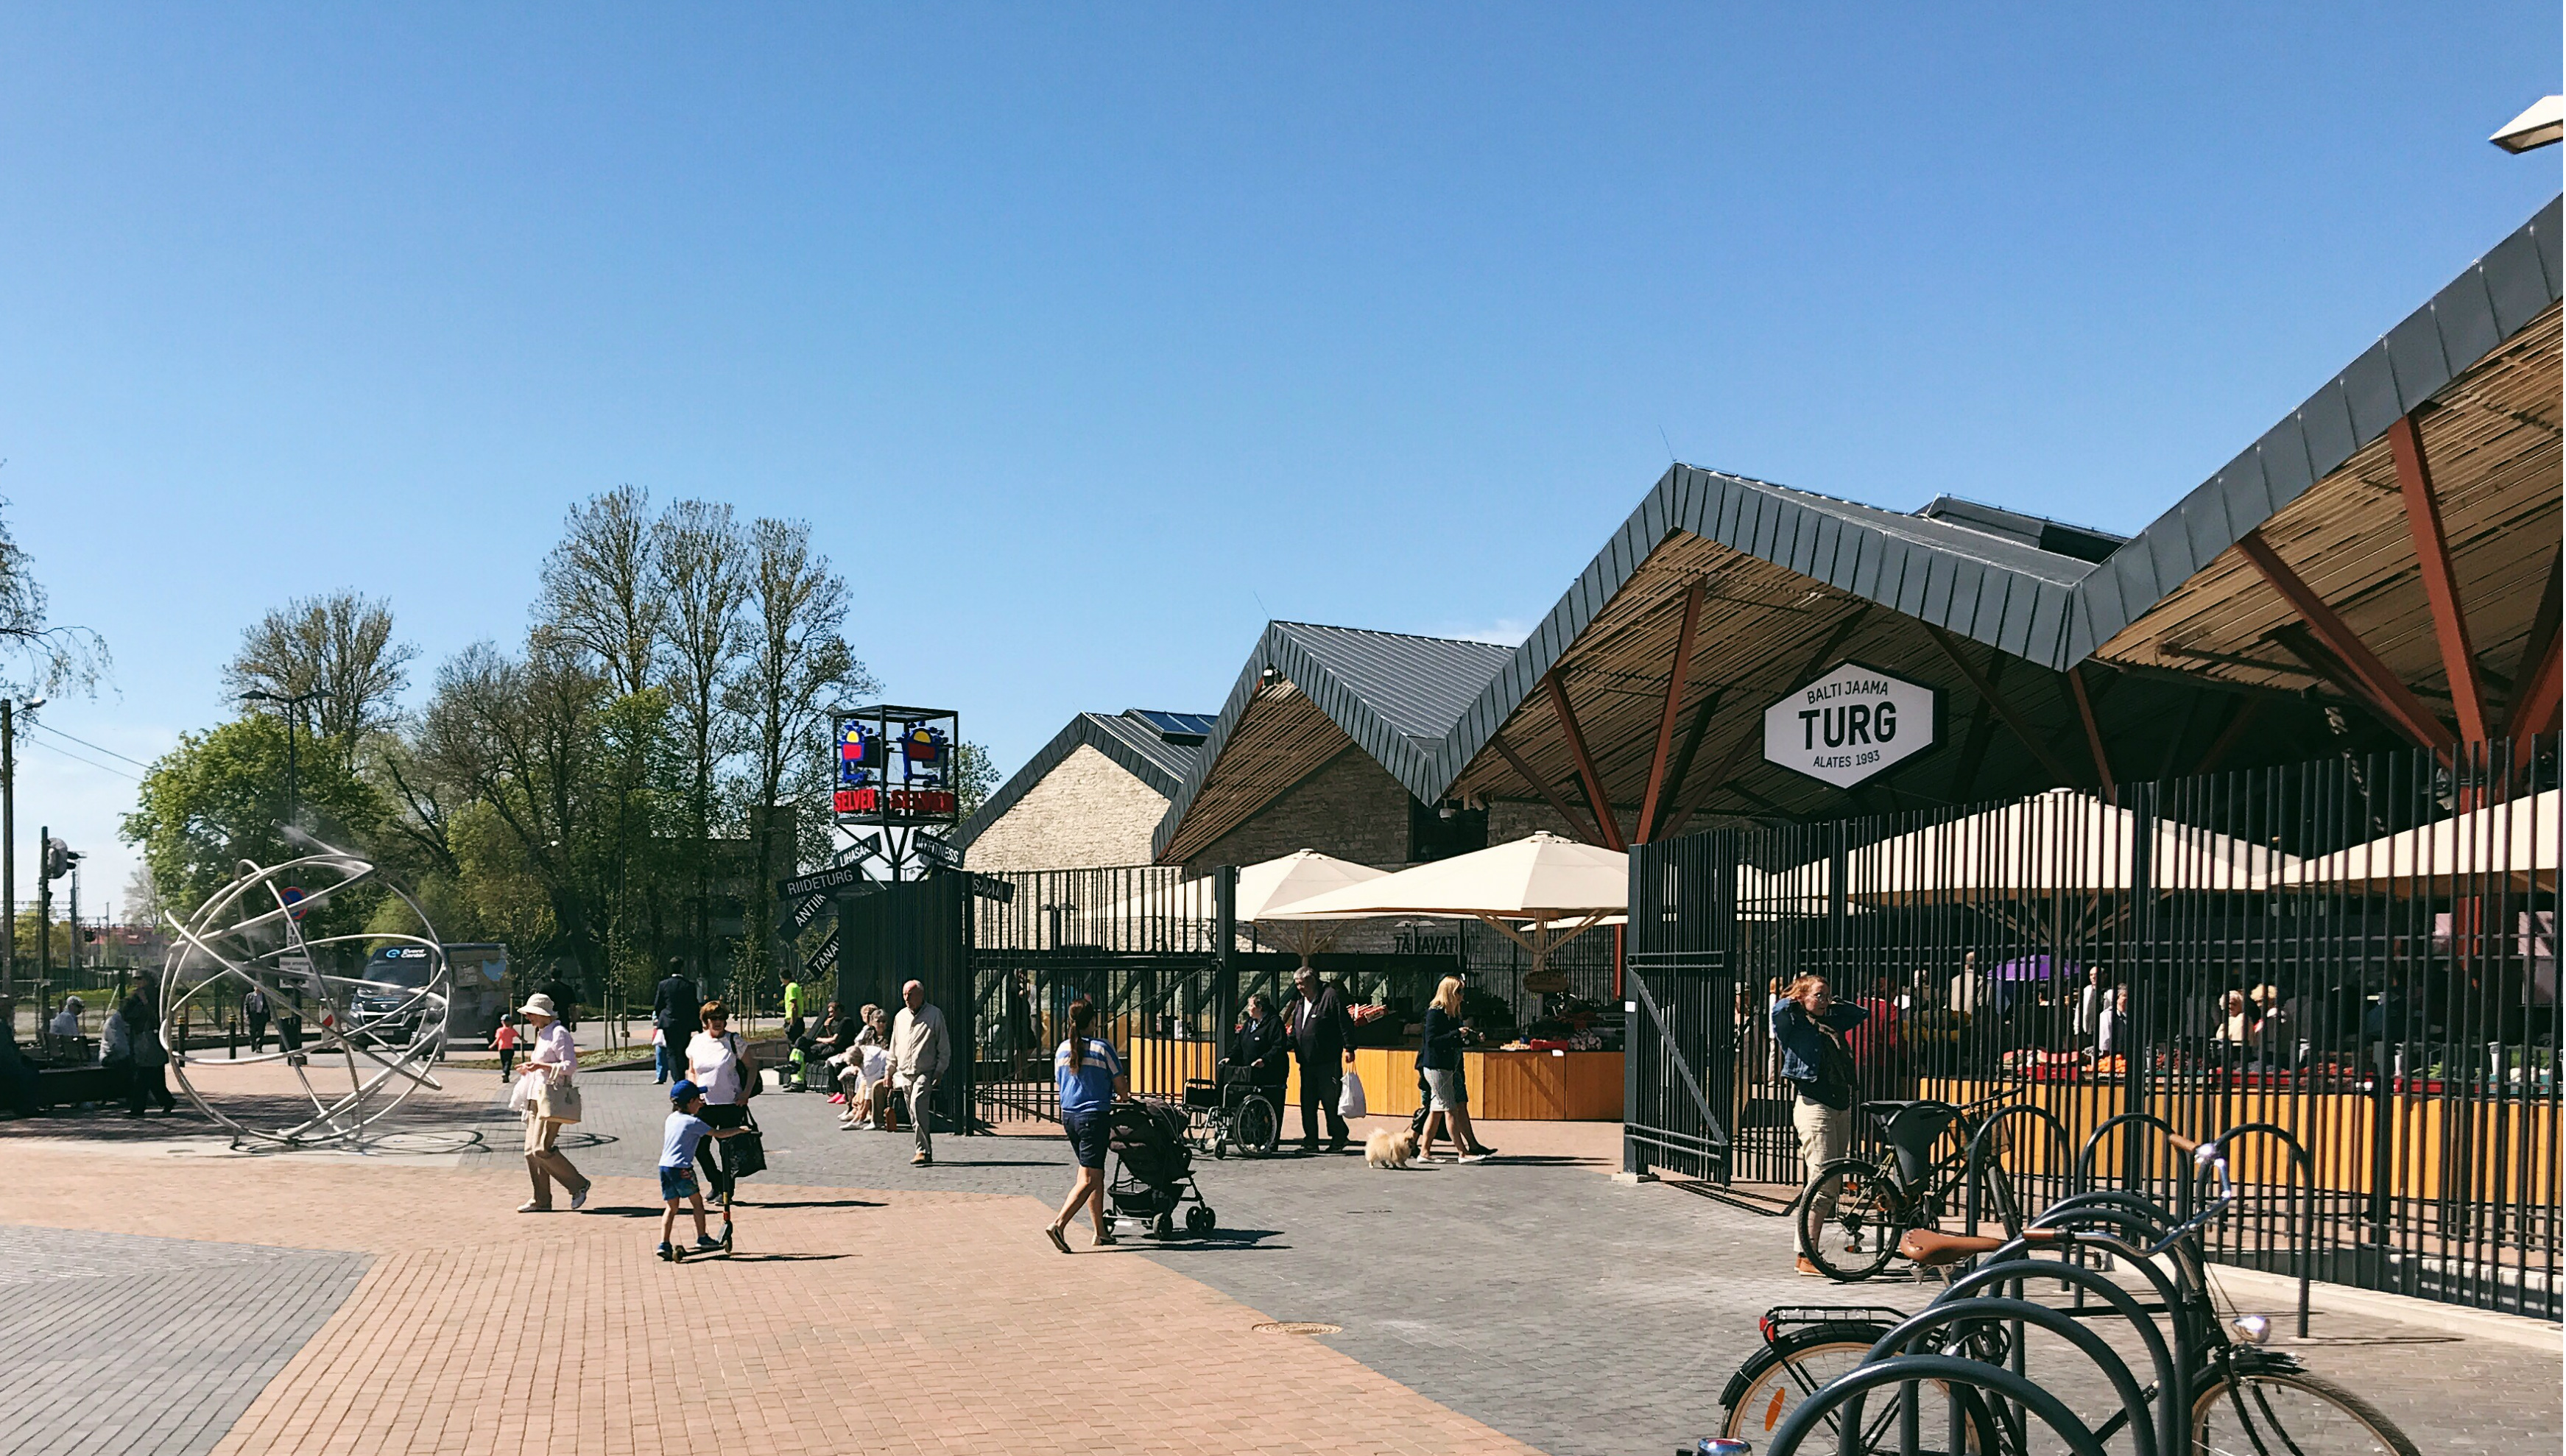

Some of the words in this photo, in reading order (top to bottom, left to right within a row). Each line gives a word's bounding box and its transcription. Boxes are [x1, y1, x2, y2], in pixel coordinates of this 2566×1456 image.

[1807, 682, 1841, 704] BALTI
[1844, 680, 1888, 696] JAAMA
[1798, 701, 1897, 750] TURG
[1813, 755, 1852, 768] ALATES
[1855, 749, 1881, 766] 1993
[833, 788, 875, 812] SELVER
[916, 835, 959, 863] MYFITNESS
[787, 869, 853, 895] RIIDETURG
[794, 893, 827, 927] ANTIIK
